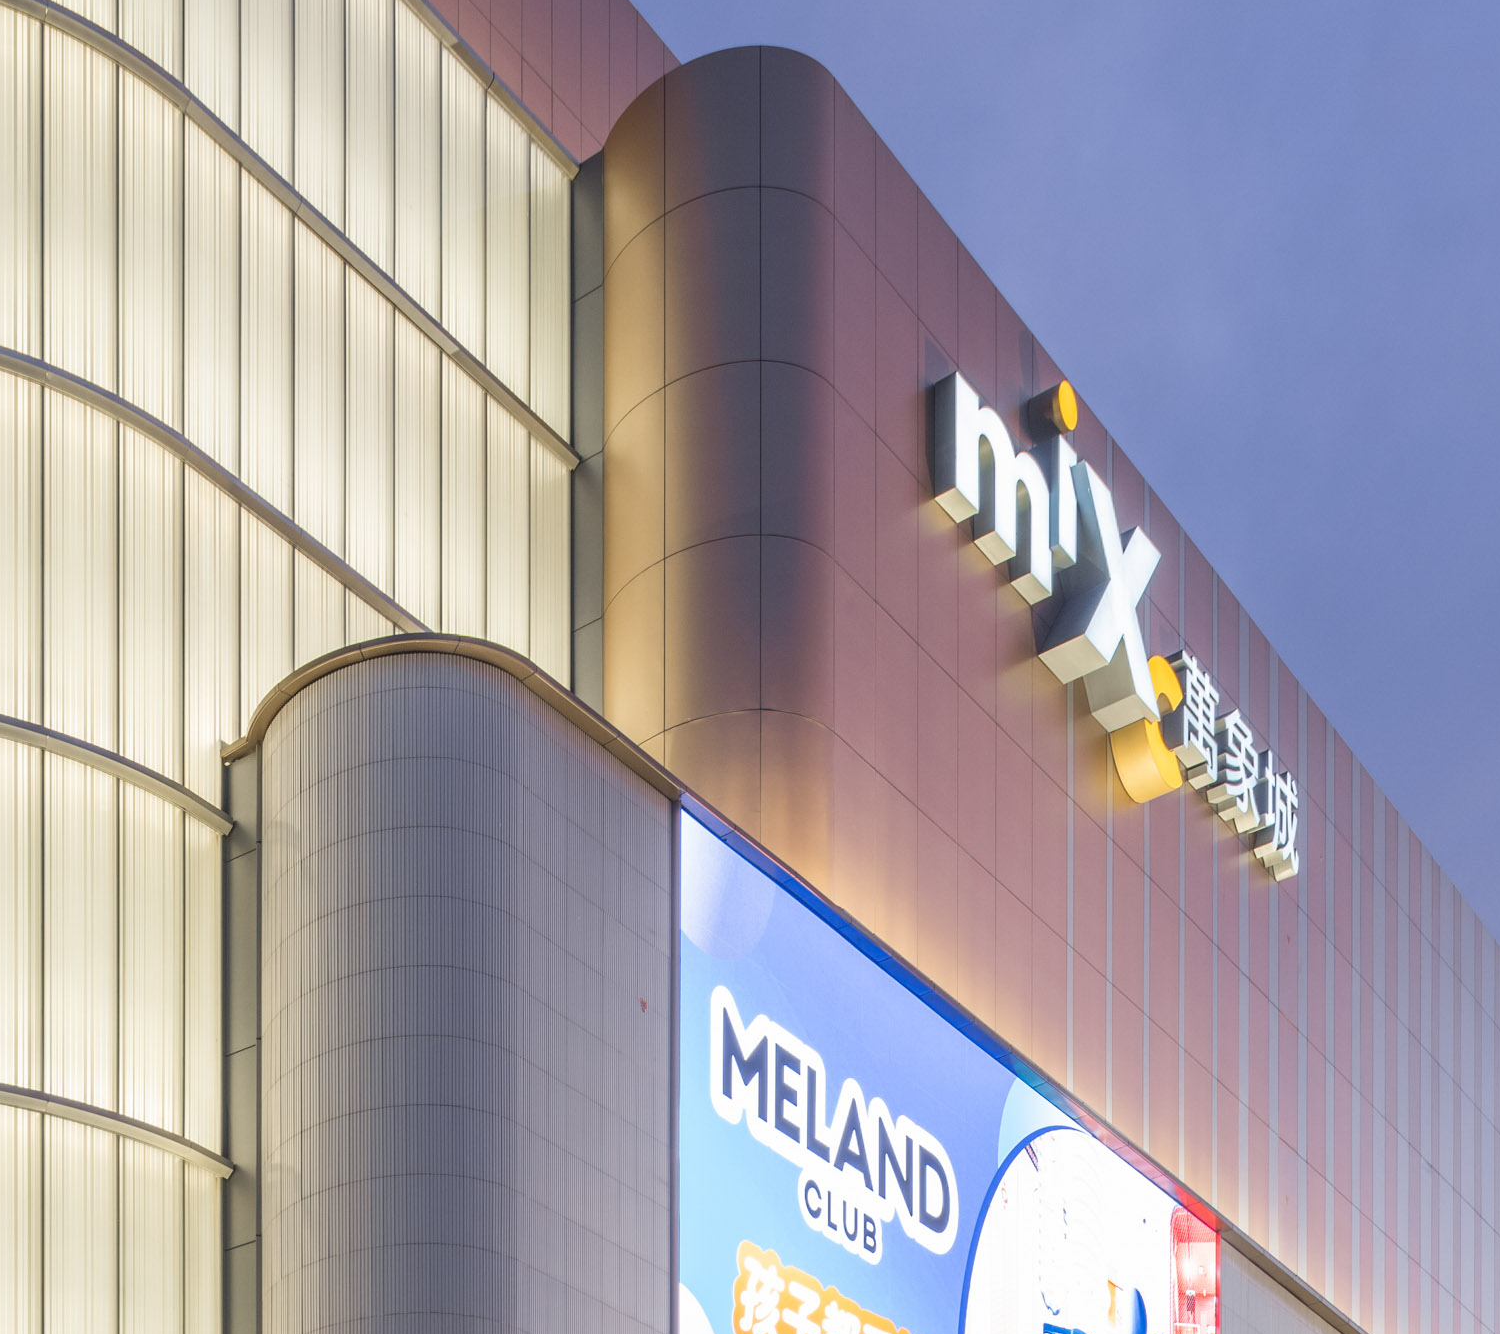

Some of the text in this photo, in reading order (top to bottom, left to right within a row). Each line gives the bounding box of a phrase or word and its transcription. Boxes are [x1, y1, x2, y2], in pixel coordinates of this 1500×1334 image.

[1178, 651, 1301, 880] 萬象城
[722, 1006, 950, 1234] MELAND
[804, 1179, 877, 1254] CLUB
